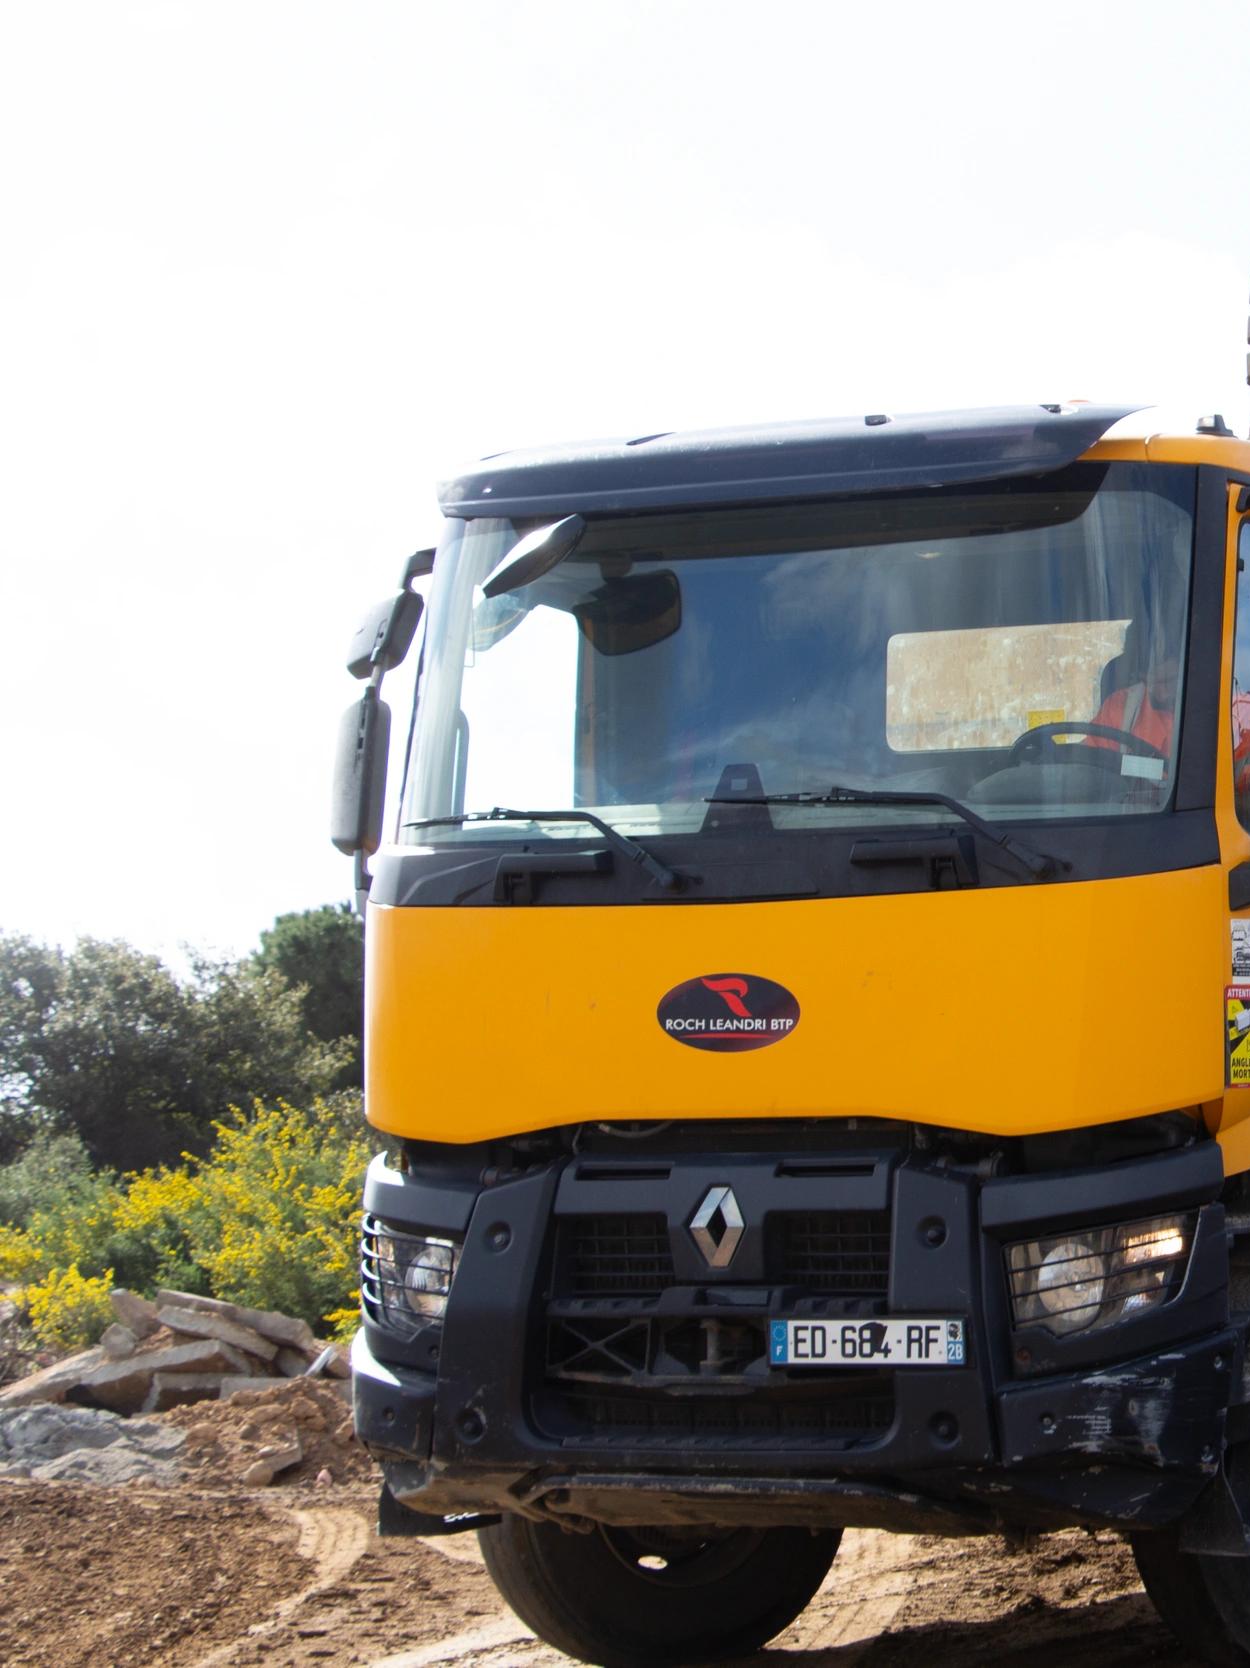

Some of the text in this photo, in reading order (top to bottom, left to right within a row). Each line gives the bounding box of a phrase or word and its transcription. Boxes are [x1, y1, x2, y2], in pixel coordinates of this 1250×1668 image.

[665, 1018, 794, 1031] ROCH LEANDRI BTP
[775, 1345, 783, 1356] F
[947, 1343, 963, 1360] 2B
